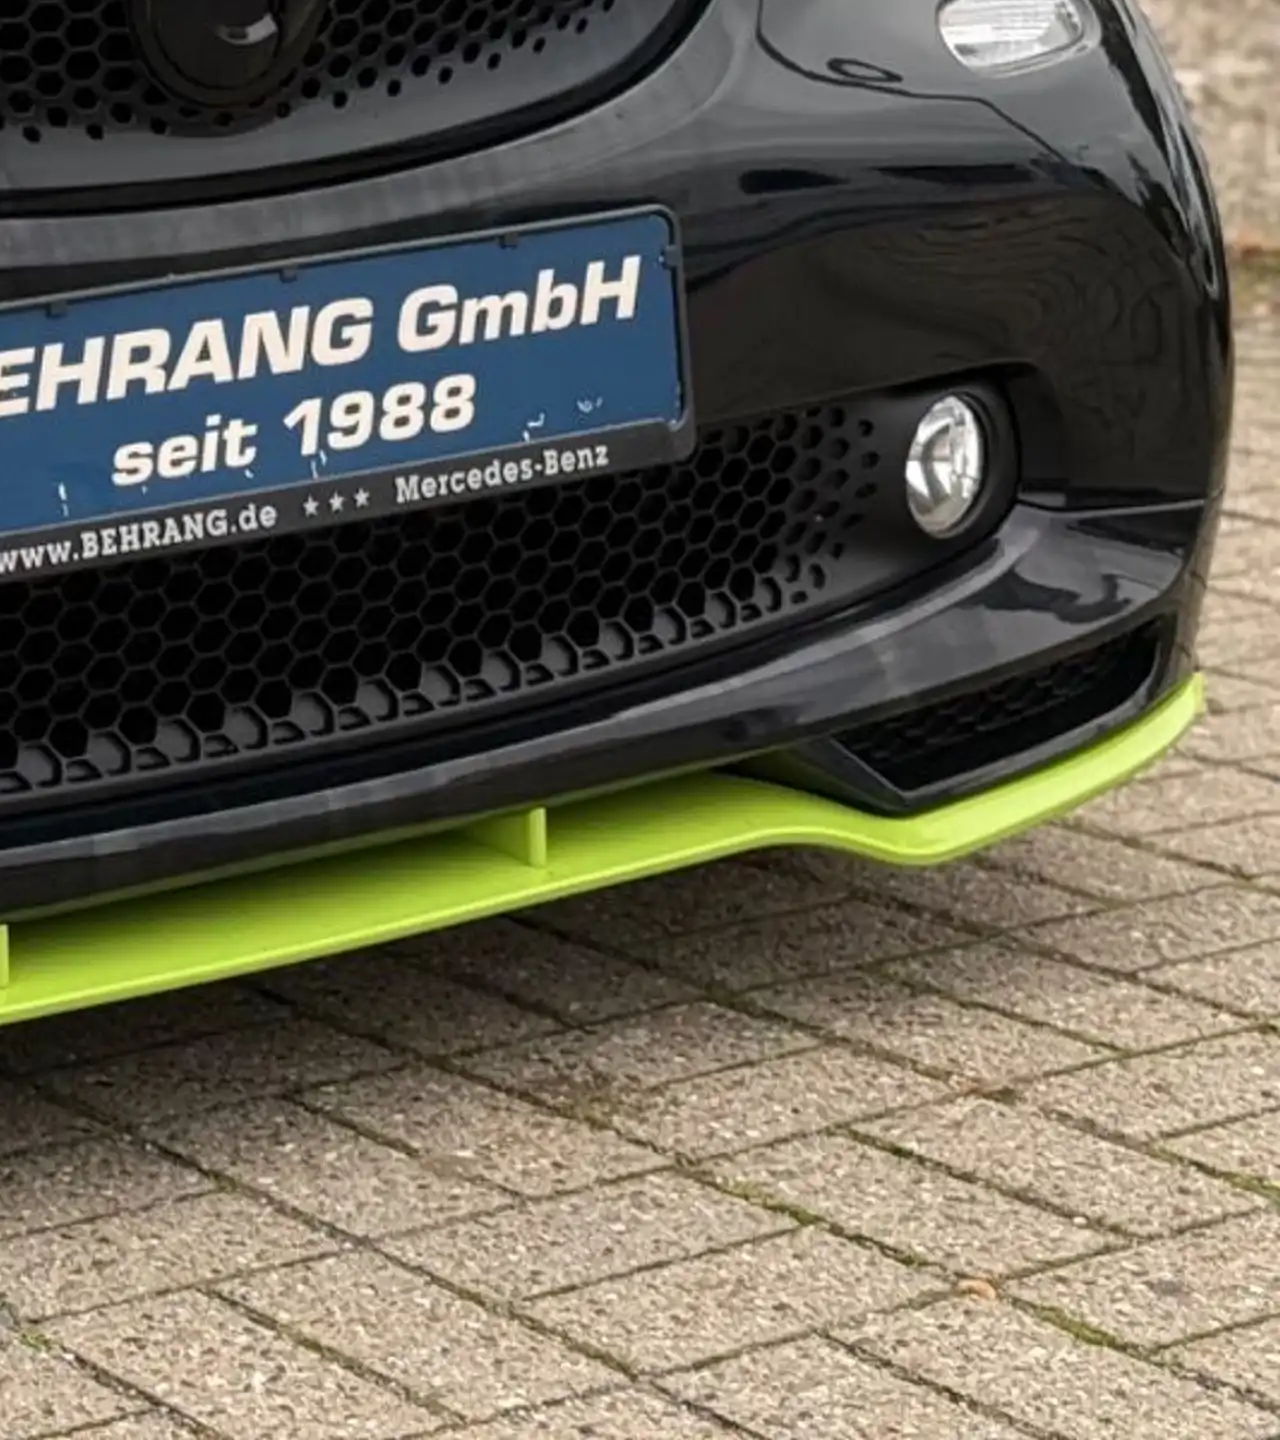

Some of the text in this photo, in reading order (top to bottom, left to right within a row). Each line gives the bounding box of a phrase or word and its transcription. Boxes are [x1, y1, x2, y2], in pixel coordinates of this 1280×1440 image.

[395, 254, 641, 353] GmbH
[111, 373, 476, 487] seit 1988
[395, 444, 610, 504] Mercedes-Benz
